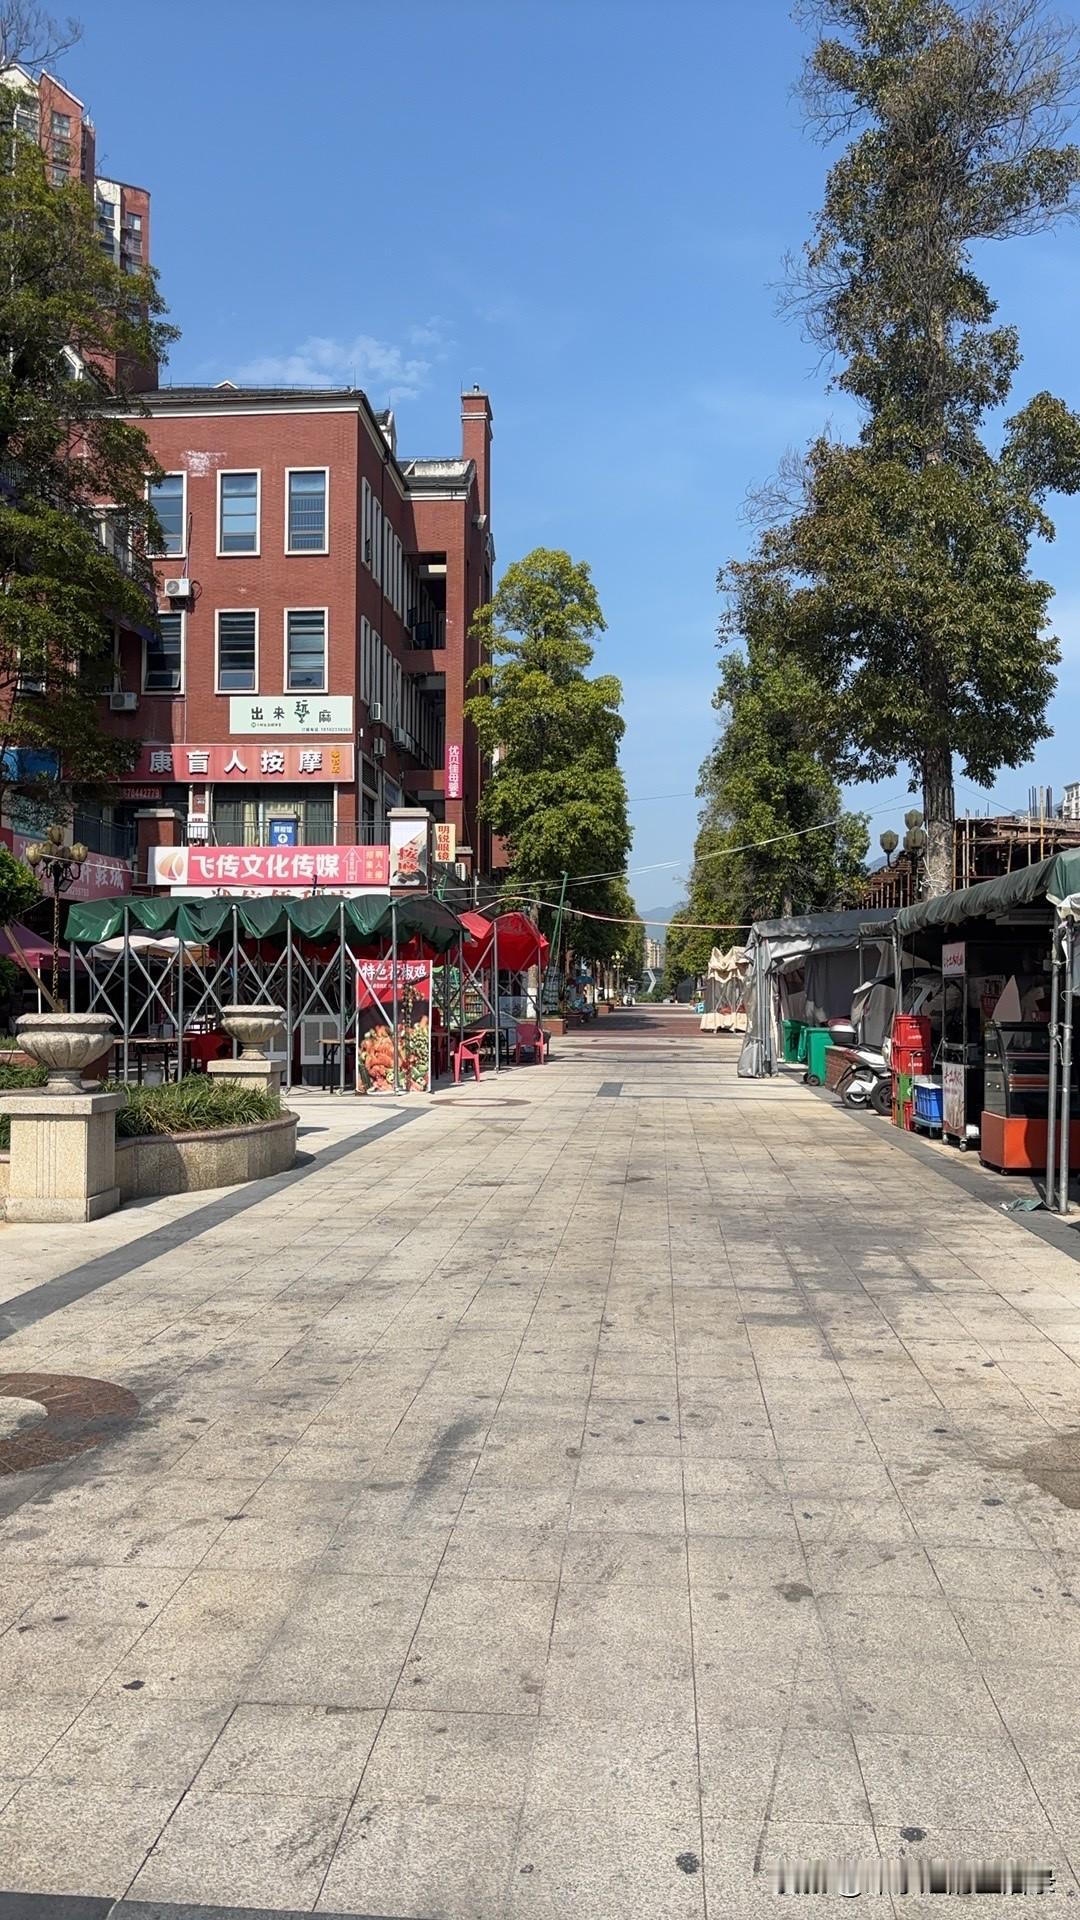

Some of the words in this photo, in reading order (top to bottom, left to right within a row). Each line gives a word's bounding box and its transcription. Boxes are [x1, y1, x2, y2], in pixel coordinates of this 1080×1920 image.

[123, 750, 323, 774] 康盲人按摩
[438, 825, 450, 860] 明锐眼镜
[193, 854, 340, 879] 飞传文化传媒
